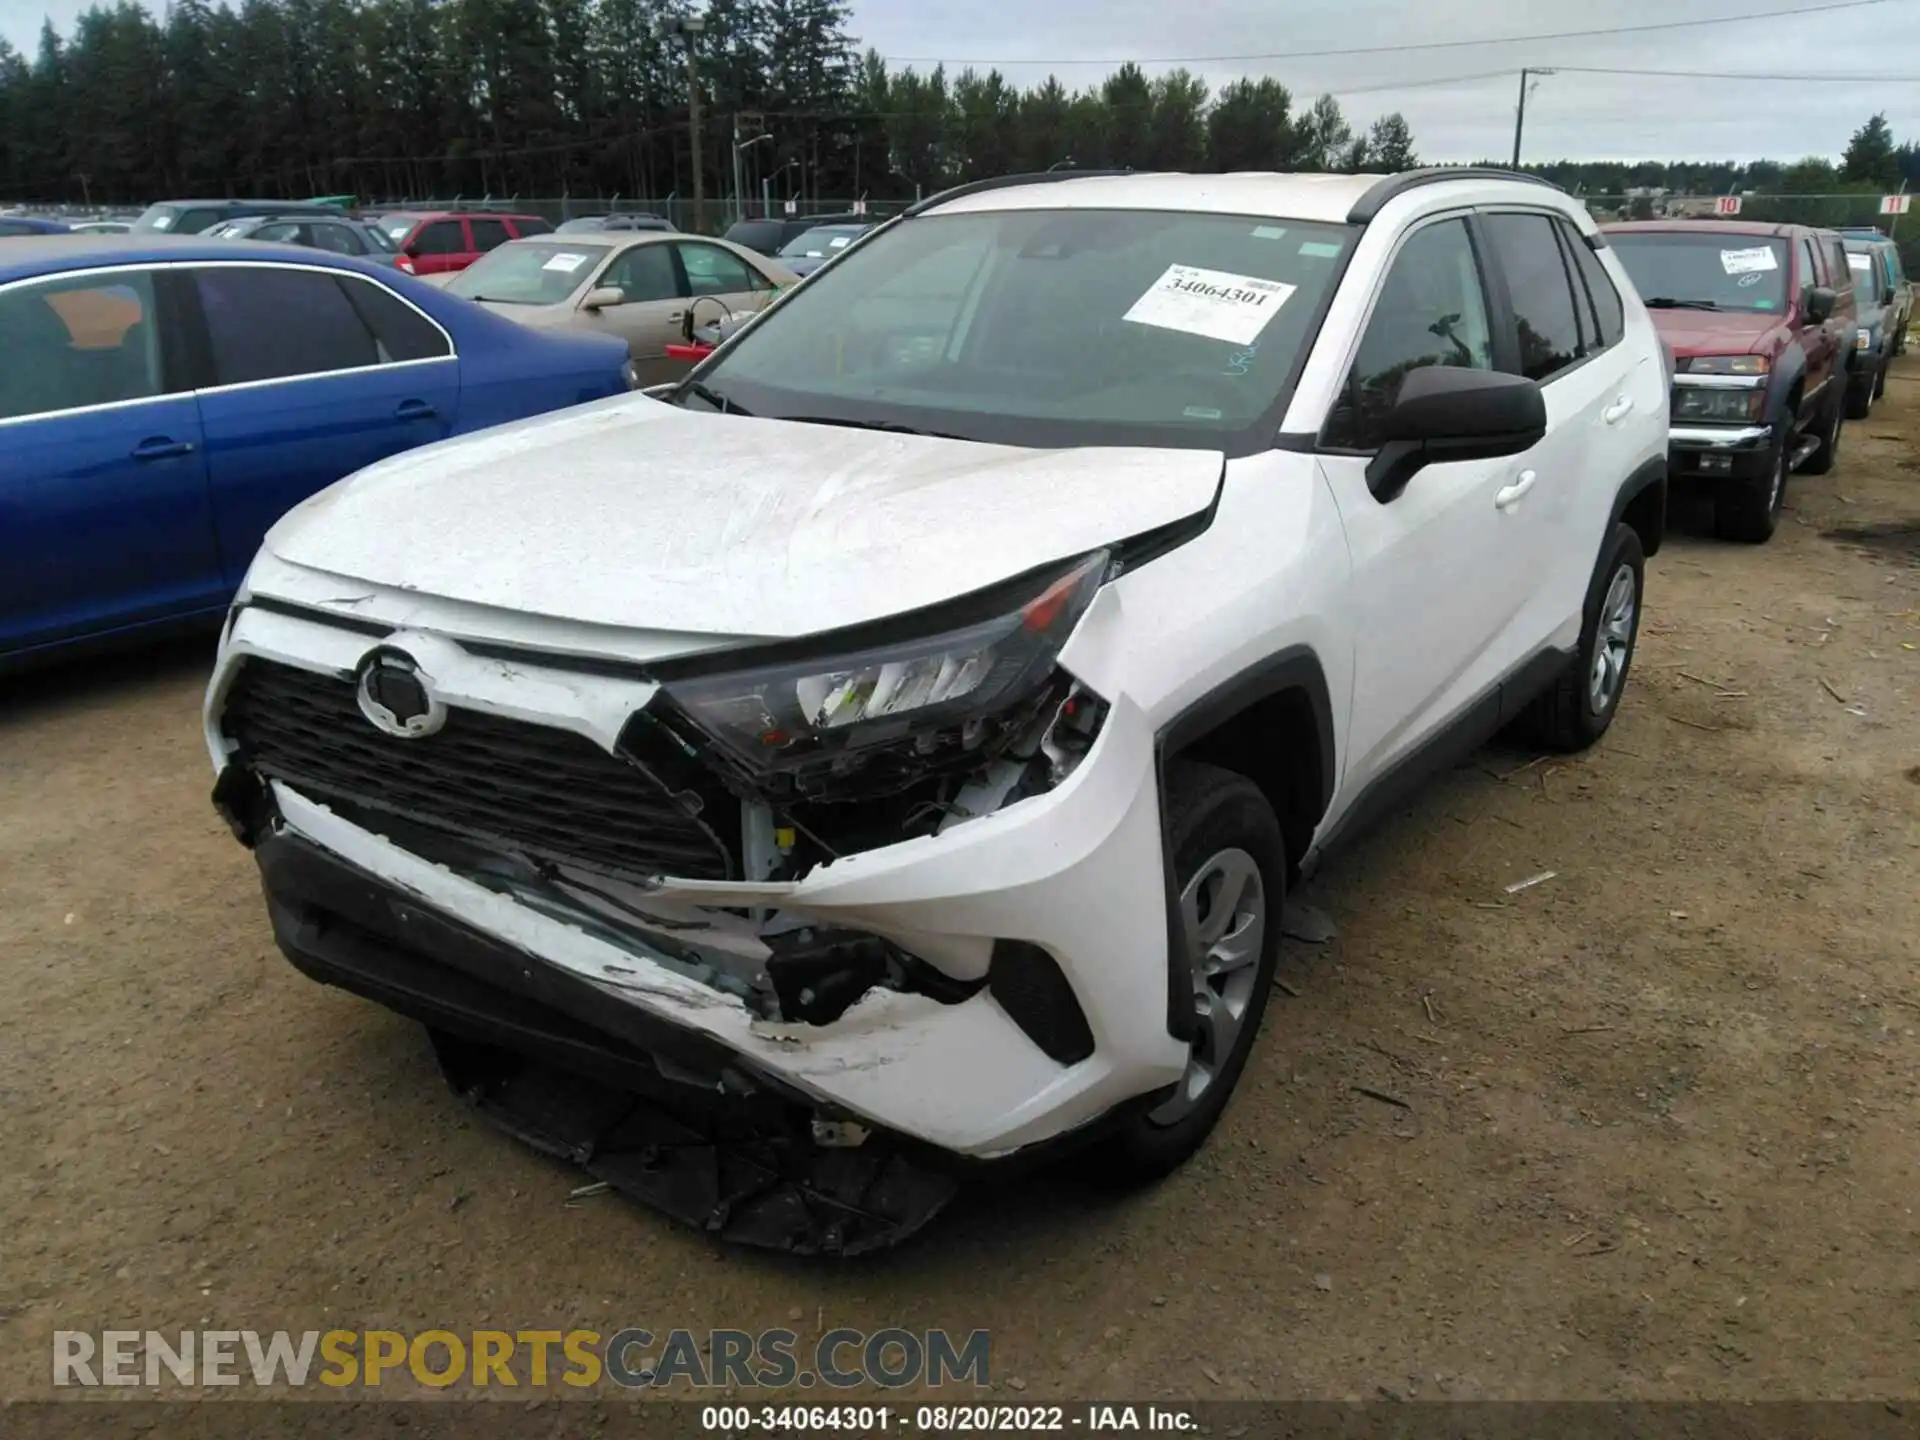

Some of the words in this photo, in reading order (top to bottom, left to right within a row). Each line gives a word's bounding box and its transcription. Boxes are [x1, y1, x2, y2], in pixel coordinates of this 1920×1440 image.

[1720, 198, 1737, 213] 10
[1887, 197, 1902, 213] 11
[1166, 278, 1268, 306] 34064301
